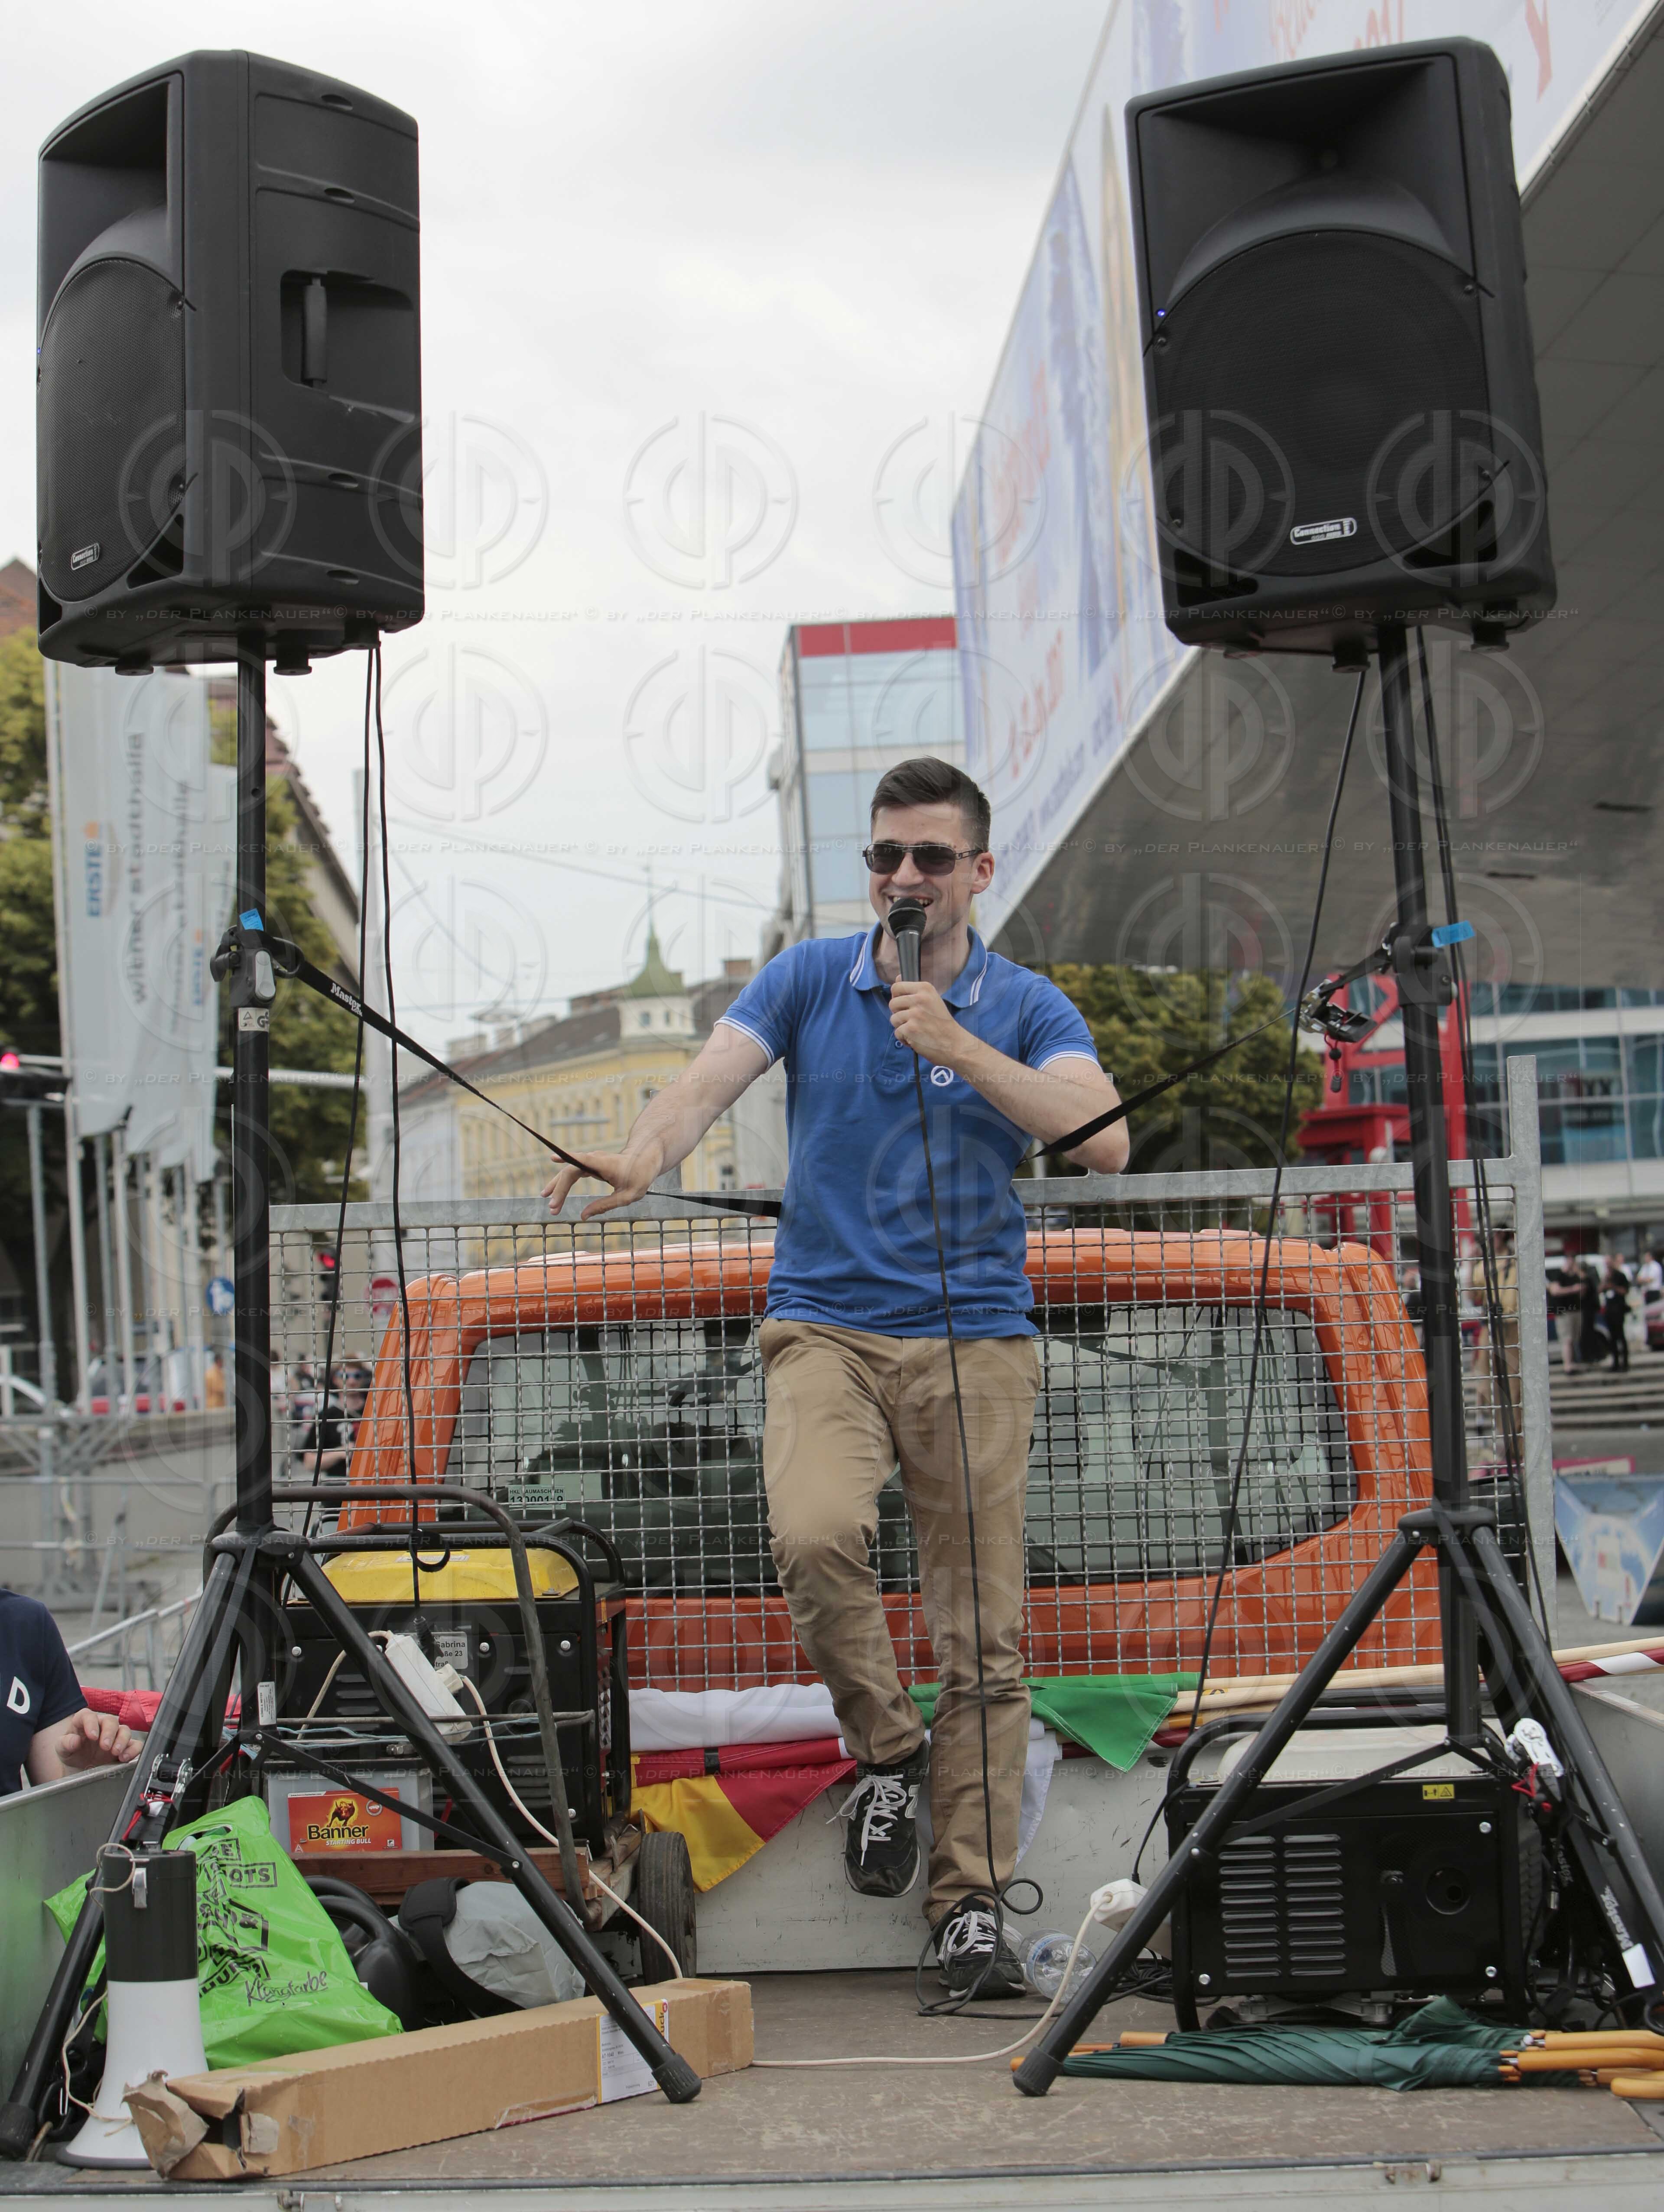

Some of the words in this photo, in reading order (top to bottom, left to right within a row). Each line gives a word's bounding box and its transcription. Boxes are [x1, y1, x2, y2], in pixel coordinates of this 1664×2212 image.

[331, 982, 361, 1010] Master
[308, 1824, 369, 1840] Banner
[245, 1970, 328, 2007] Klangfarbe
